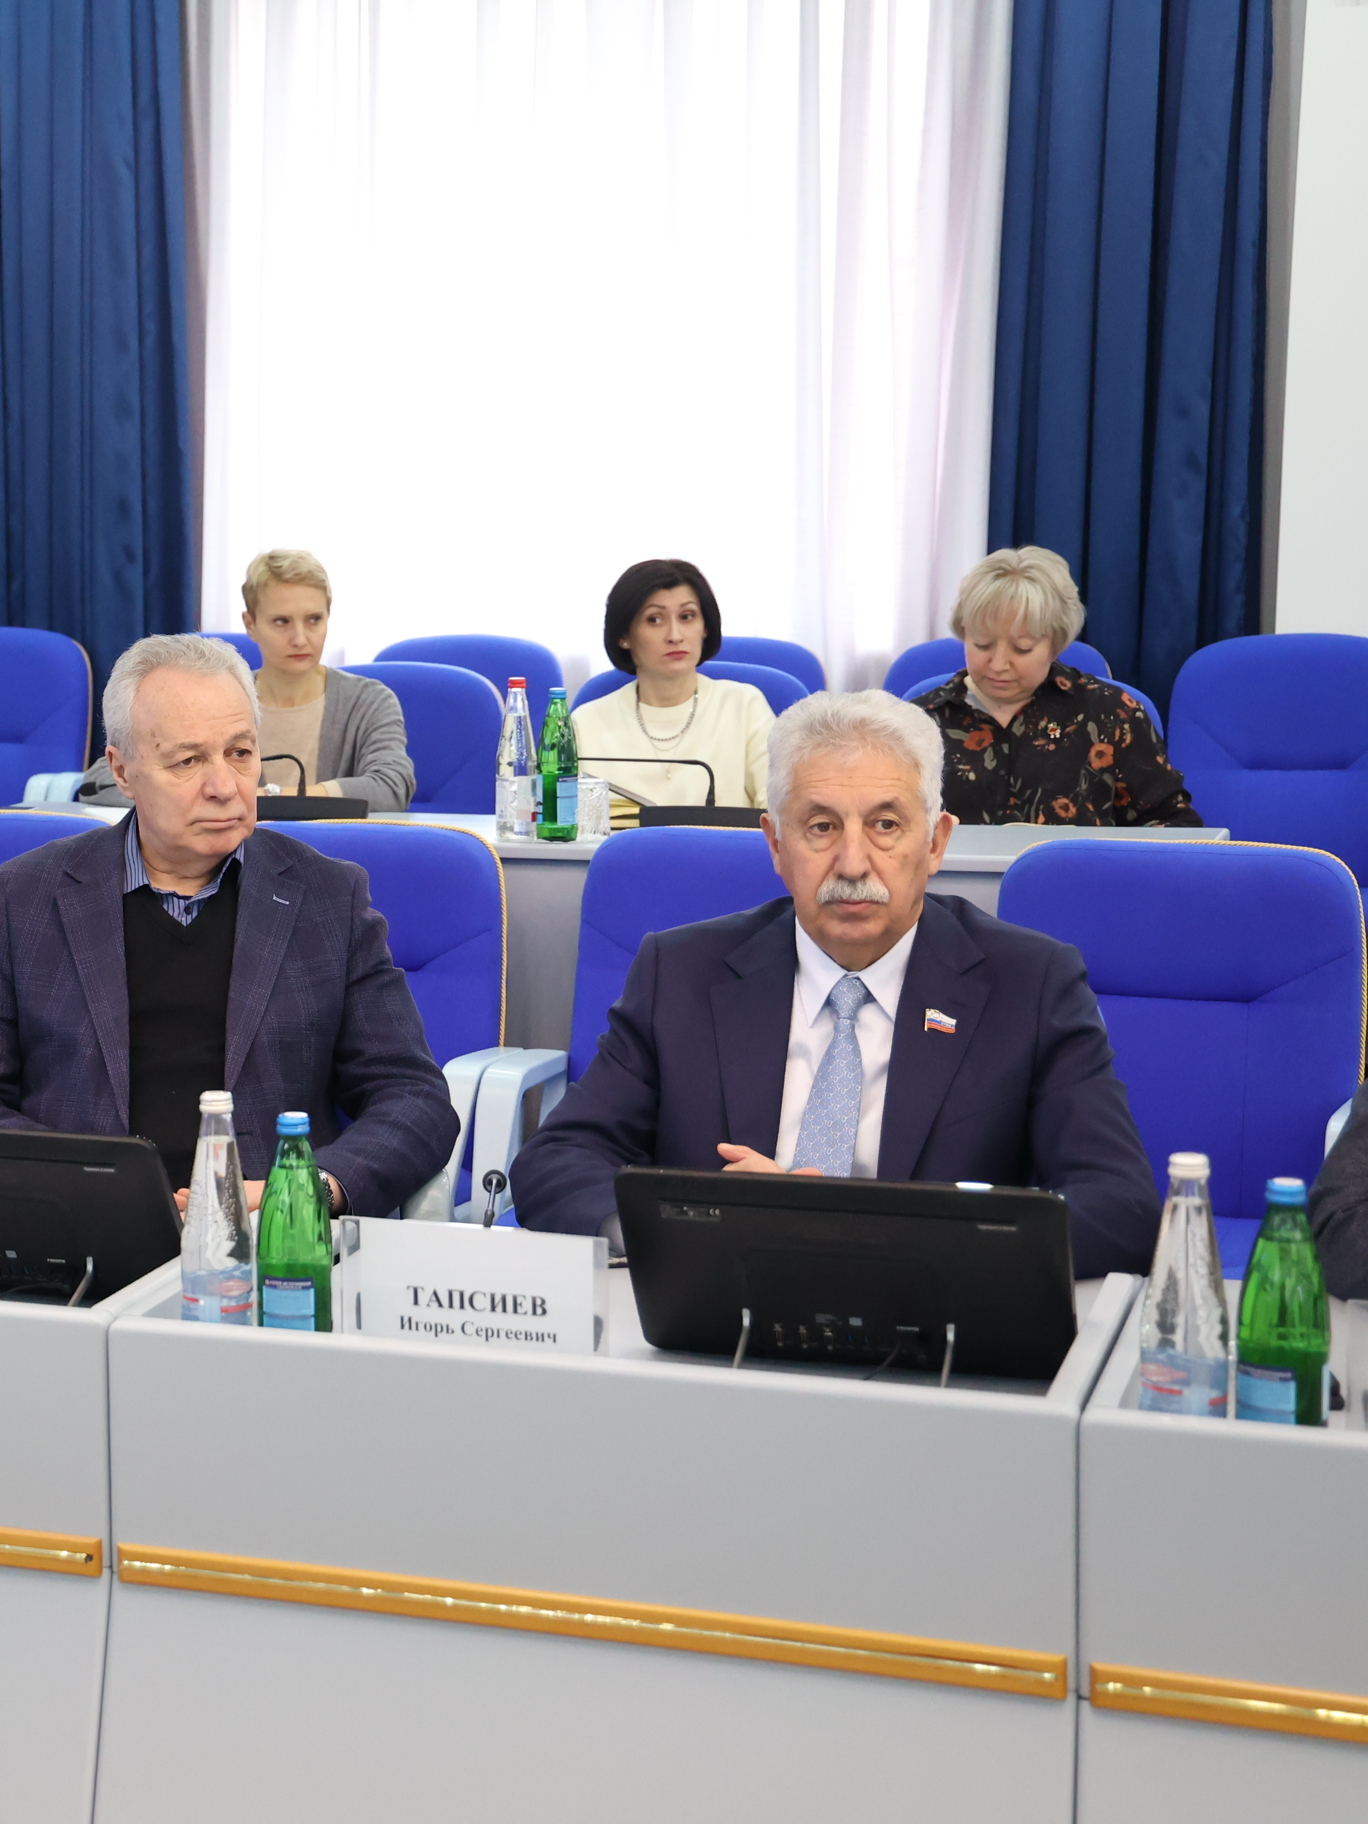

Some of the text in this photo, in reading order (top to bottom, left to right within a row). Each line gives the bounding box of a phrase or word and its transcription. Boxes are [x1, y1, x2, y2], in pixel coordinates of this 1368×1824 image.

[406, 1285, 548, 1317] ТАПСИЕВ
[399, 1314, 557, 1344] Игорь Сергеевич
